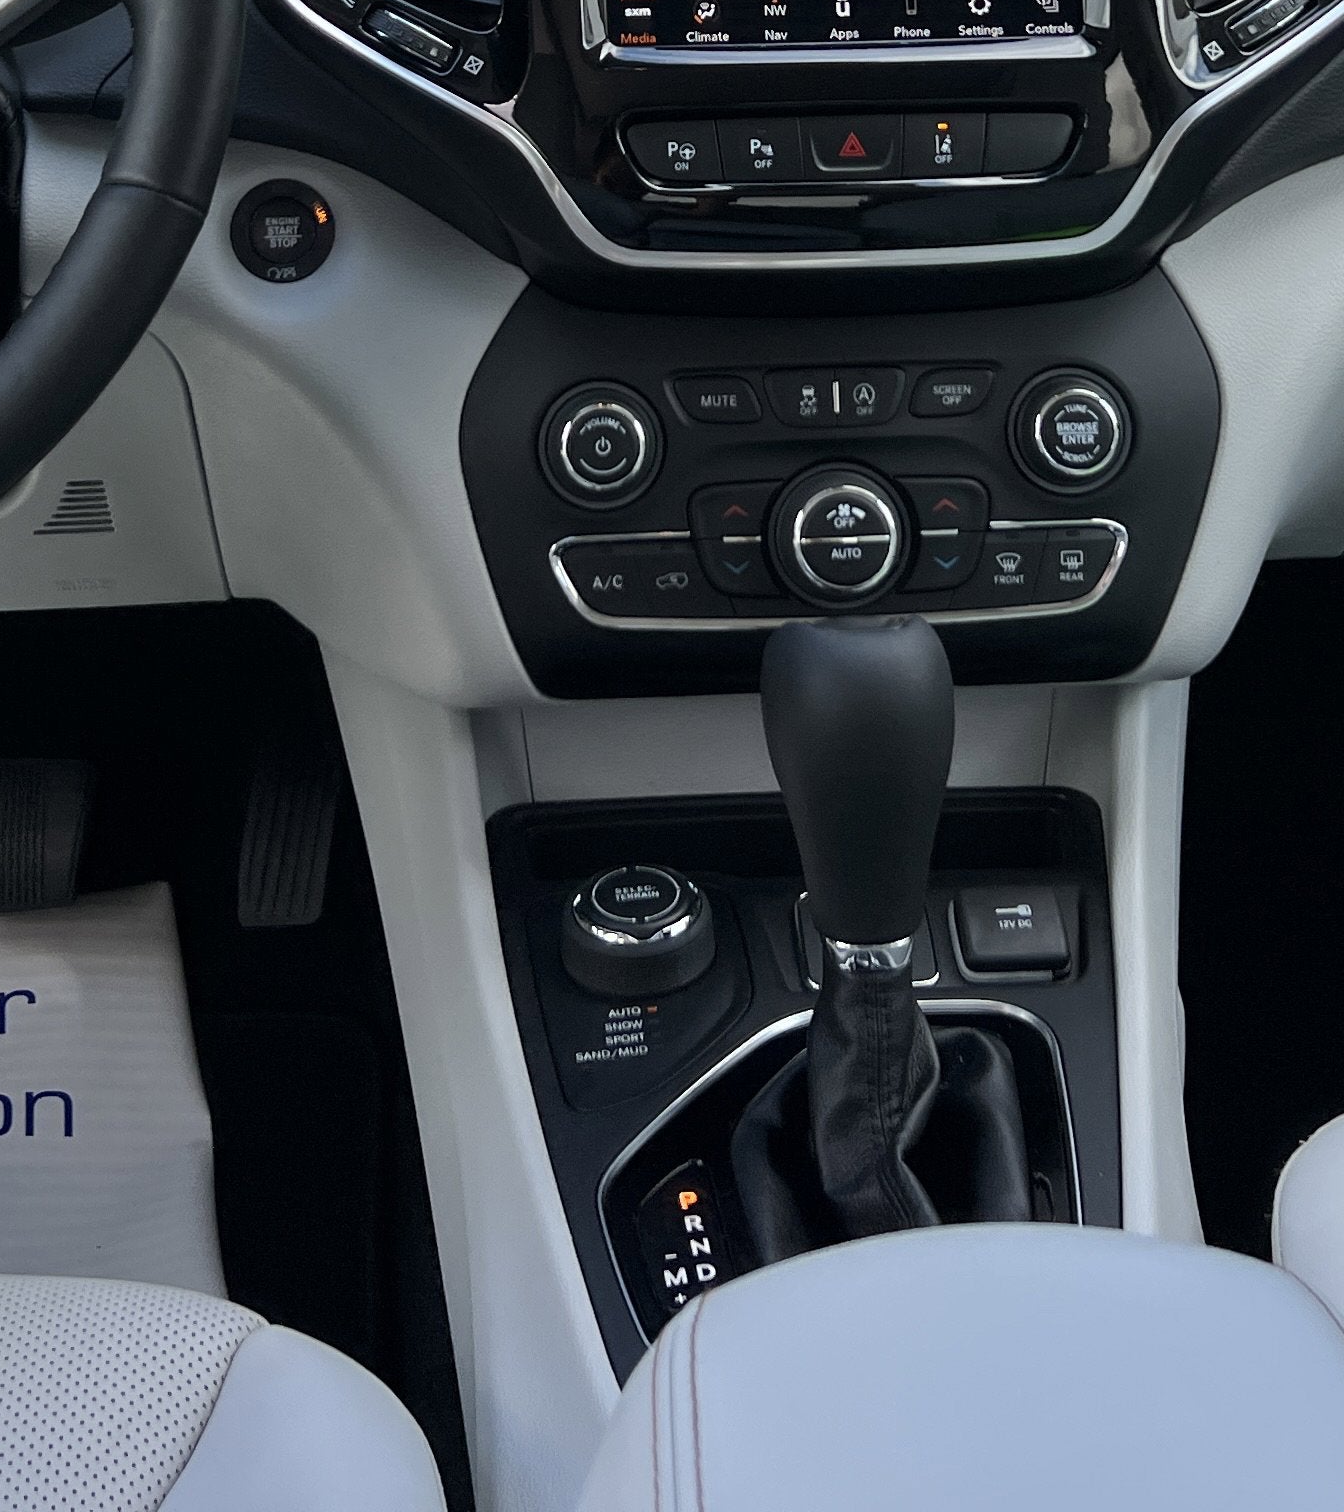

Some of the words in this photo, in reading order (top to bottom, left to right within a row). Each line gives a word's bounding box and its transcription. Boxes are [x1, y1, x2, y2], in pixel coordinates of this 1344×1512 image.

[624, 8, 651, 17] sxm
[764, 5, 787, 16] NW
[830, 29, 859, 39] Apps
[894, 27, 931, 38] Phone
[958, 25, 1004, 38] Settings
[1025, 23, 1074, 34] Controls
[620, 33, 657, 43] Media
[686, 32, 729, 43] Climate
[765, 30, 788, 40] Nav
[754, 159, 773, 169] OFF
[935, 155, 953, 164] OFF
[674, 162, 689, 171] ON
[265, 216, 300, 226] ENGINE
[267, 226, 298, 235] START
[269, 237, 298, 248] STOP
[933, 384, 972, 396] SCREEN
[700, 394, 738, 407] MUTE
[942, 395, 962, 406] OFF
[800, 406, 817, 416] OFF
[856, 406, 874, 416] OFF
[1063, 403, 1088, 415] TUNE
[584, 416, 621, 430] VOLUME
[1056, 421, 1099, 433] BROWSE
[1062, 433, 1095, 445] ENTER
[1062, 450, 1093, 462] SCROLL
[833, 517, 856, 529] OFF
[831, 548, 862, 560] AUTO
[592, 574, 623, 589] A/C
[994, 574, 1025, 585] FRONT
[1060, 571, 1084, 582] REAR
[999, 919, 1016, 929] 12V
[608, 1006, 642, 1018] AUTO
[604, 1019, 643, 1033] SNOW
[605, 1032, 644, 1046] SPORT
[575, 1045, 649, 1063] SAND/MUD
[678, 1191, 698, 1210] P
[684, 1215, 705, 1232] R
[690, 1237, 712, 1257] N
[663, 1267, 688, 1288] M
[696, 1263, 717, 1282] D
